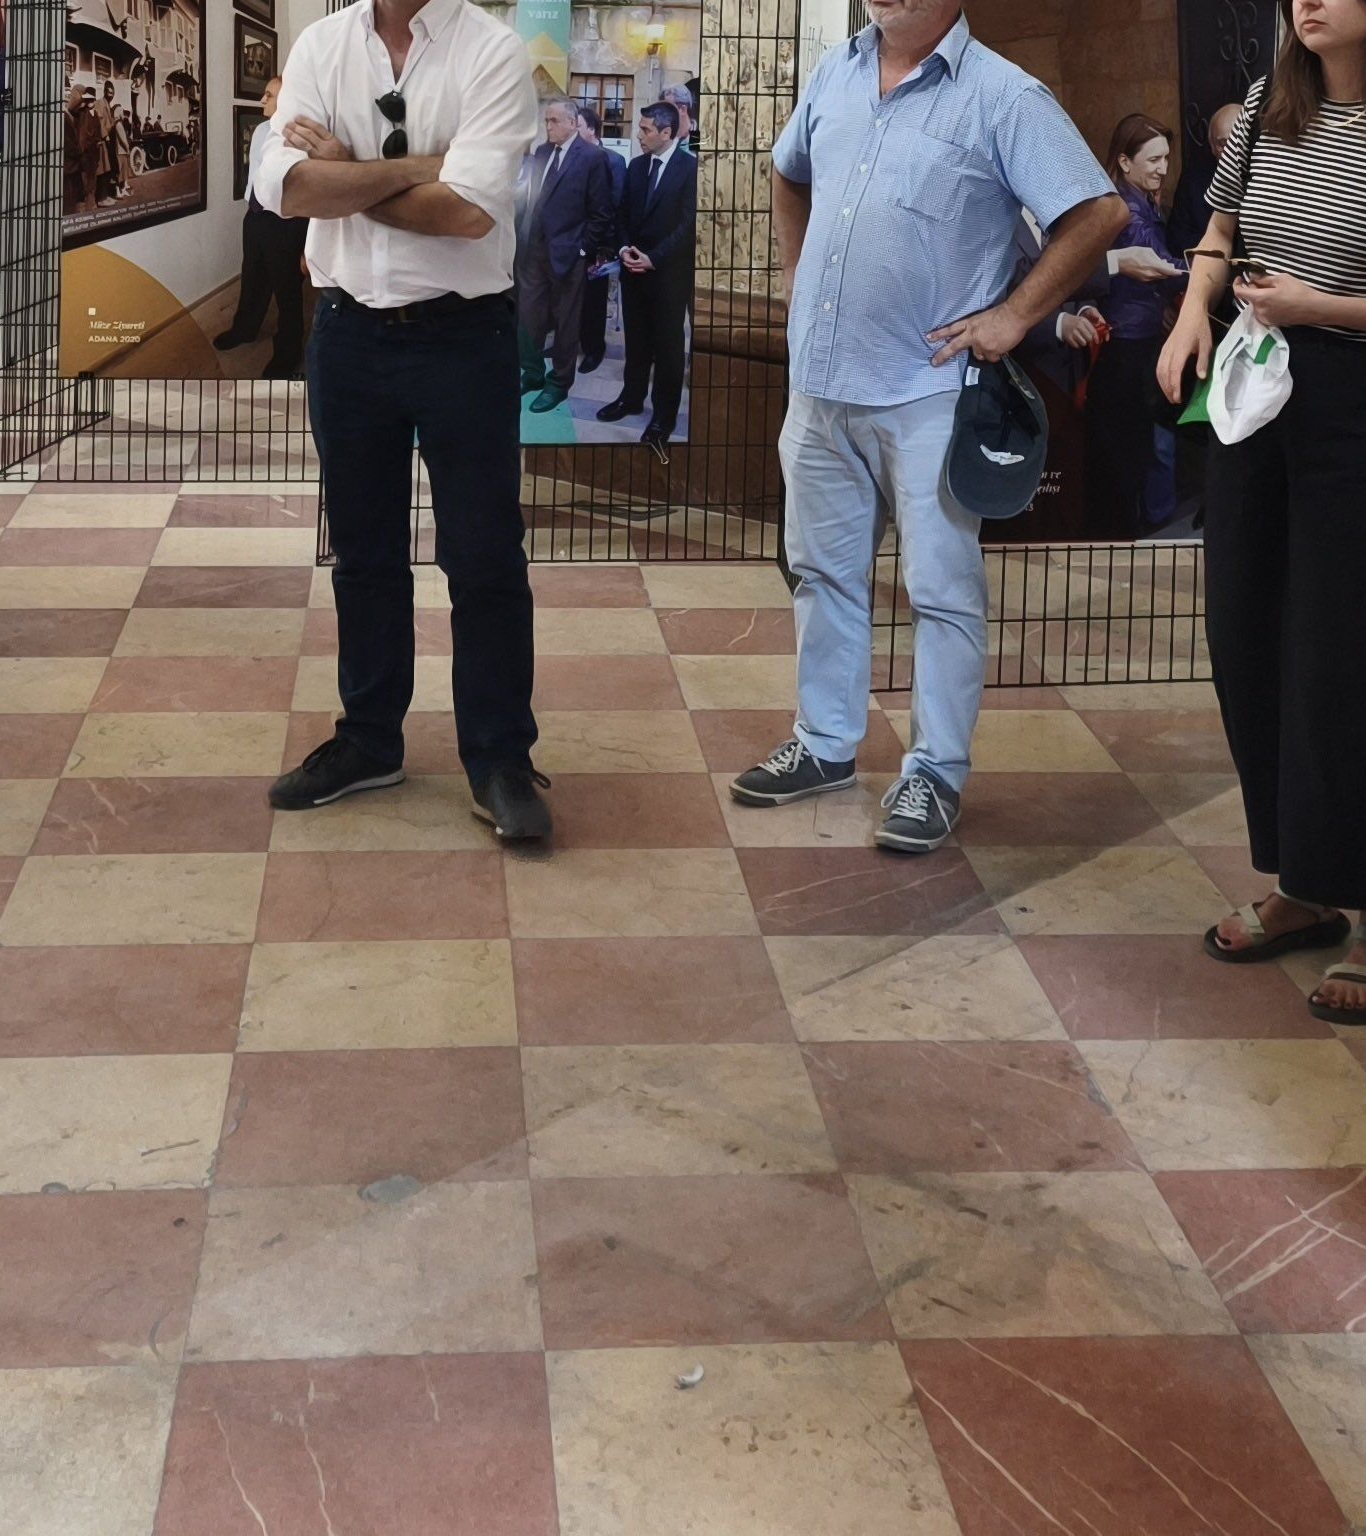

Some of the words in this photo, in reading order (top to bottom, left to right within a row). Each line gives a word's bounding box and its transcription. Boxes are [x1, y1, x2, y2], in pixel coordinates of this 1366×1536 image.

[527, 9, 559, 19] varız
[88, 335, 119, 343] ADANA
[119, 335, 141, 343] 2020
[1036, 482, 1061, 496] çılışı
